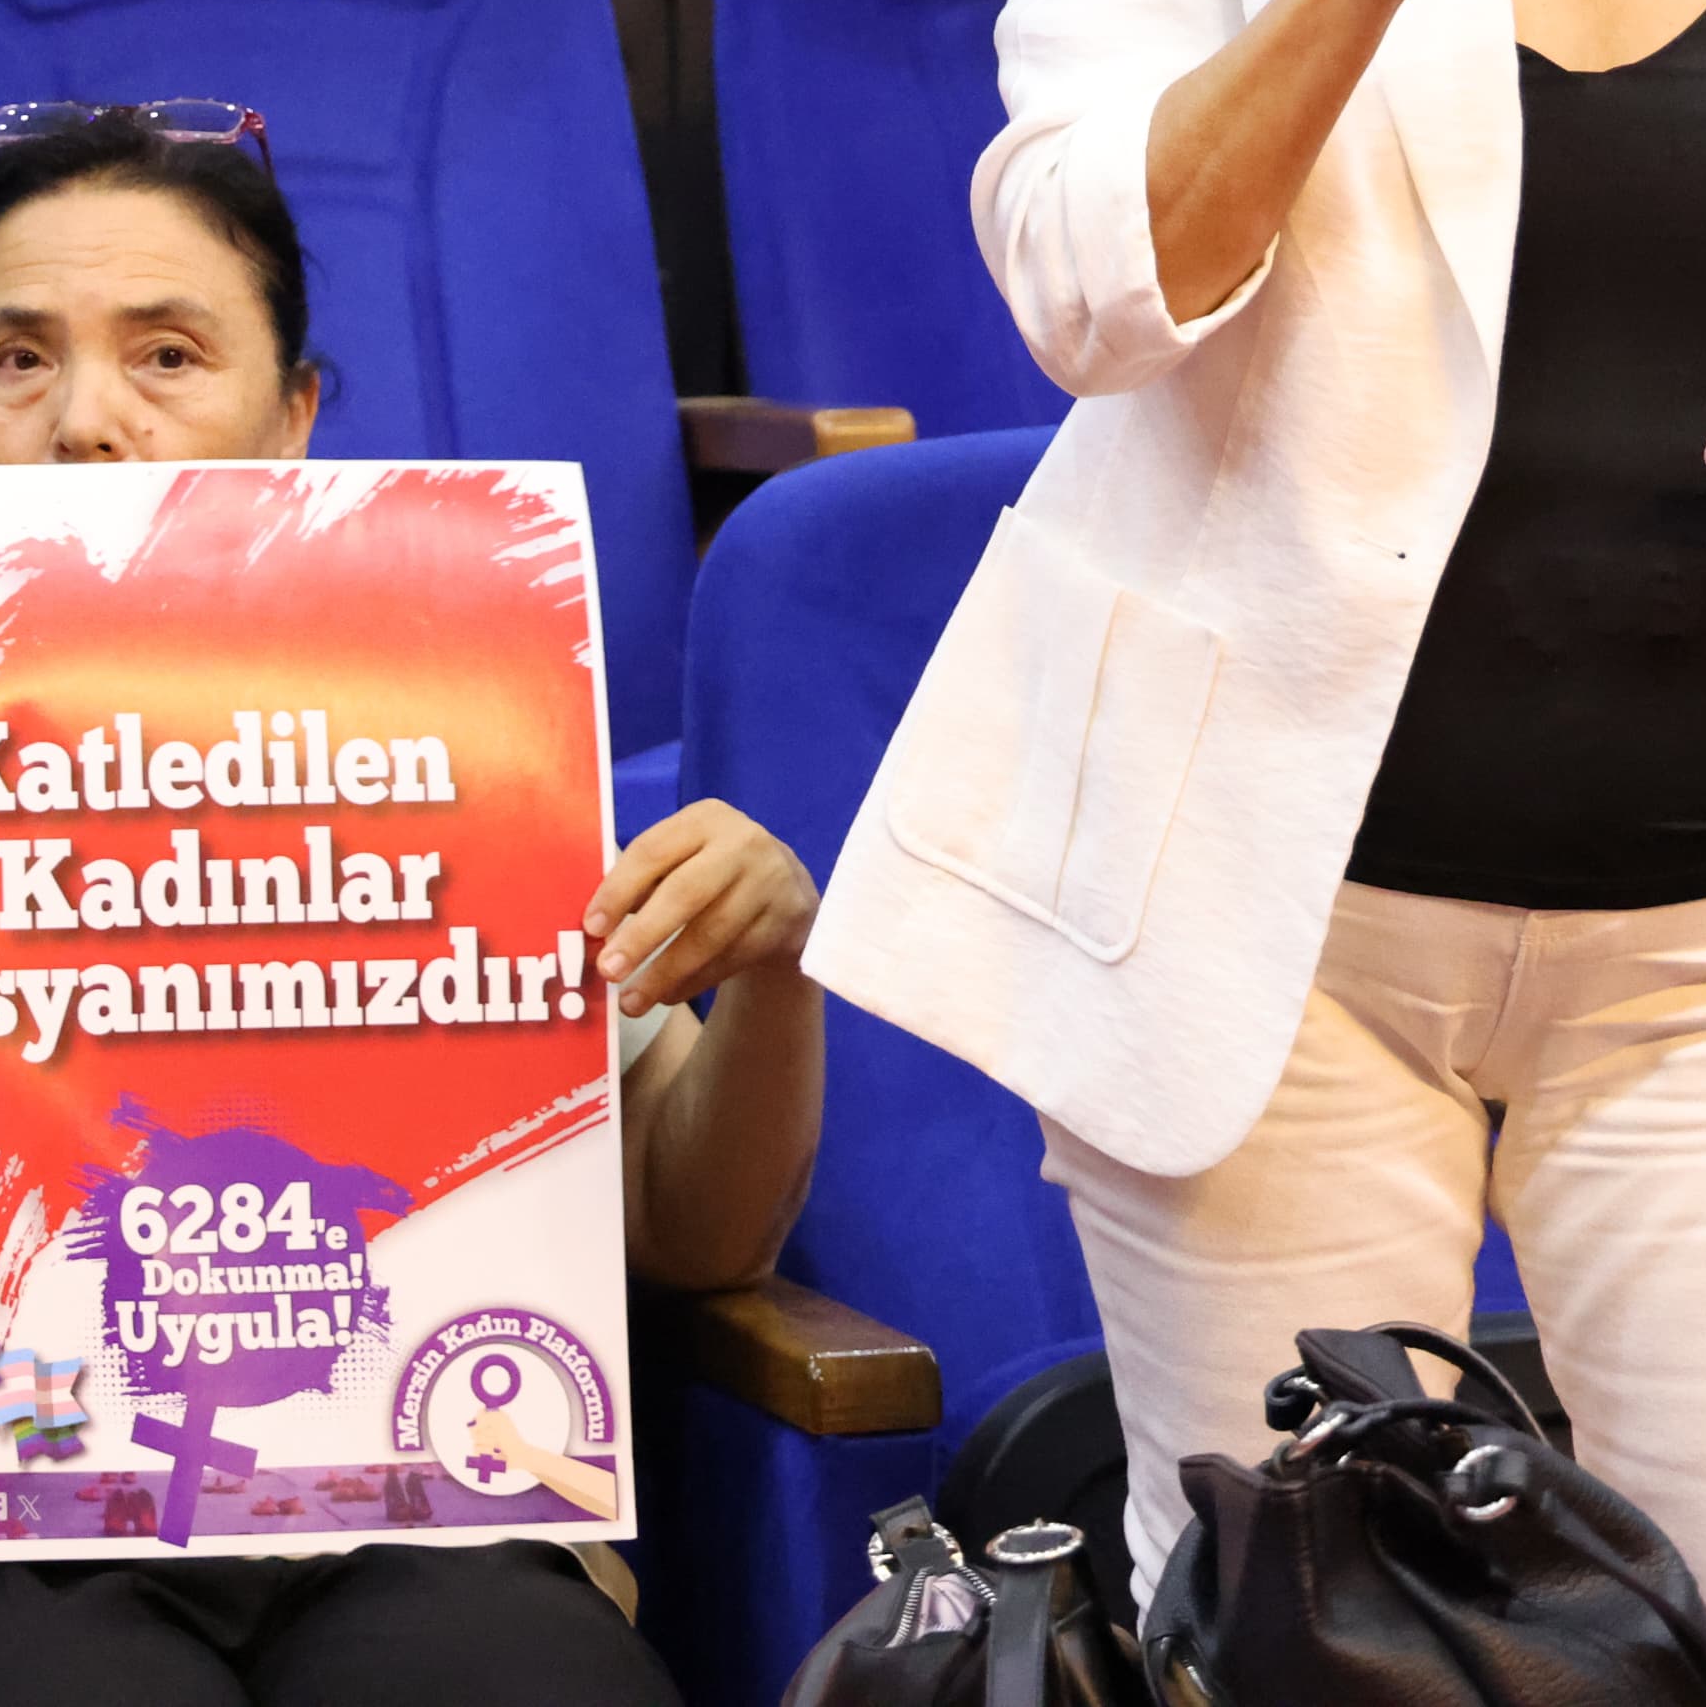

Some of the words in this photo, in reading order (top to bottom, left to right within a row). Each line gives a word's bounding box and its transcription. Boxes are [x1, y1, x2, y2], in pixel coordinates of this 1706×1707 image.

[119, 1181, 349, 1256] 6284'e
[140, 1252, 365, 1297] Dokunma!
[114, 1293, 353, 1368] Uygula!
[396, 1348, 445, 1449] Mersin
[436, 1313, 522, 1355] Kadın
[523, 1317, 606, 1442] Platformu
